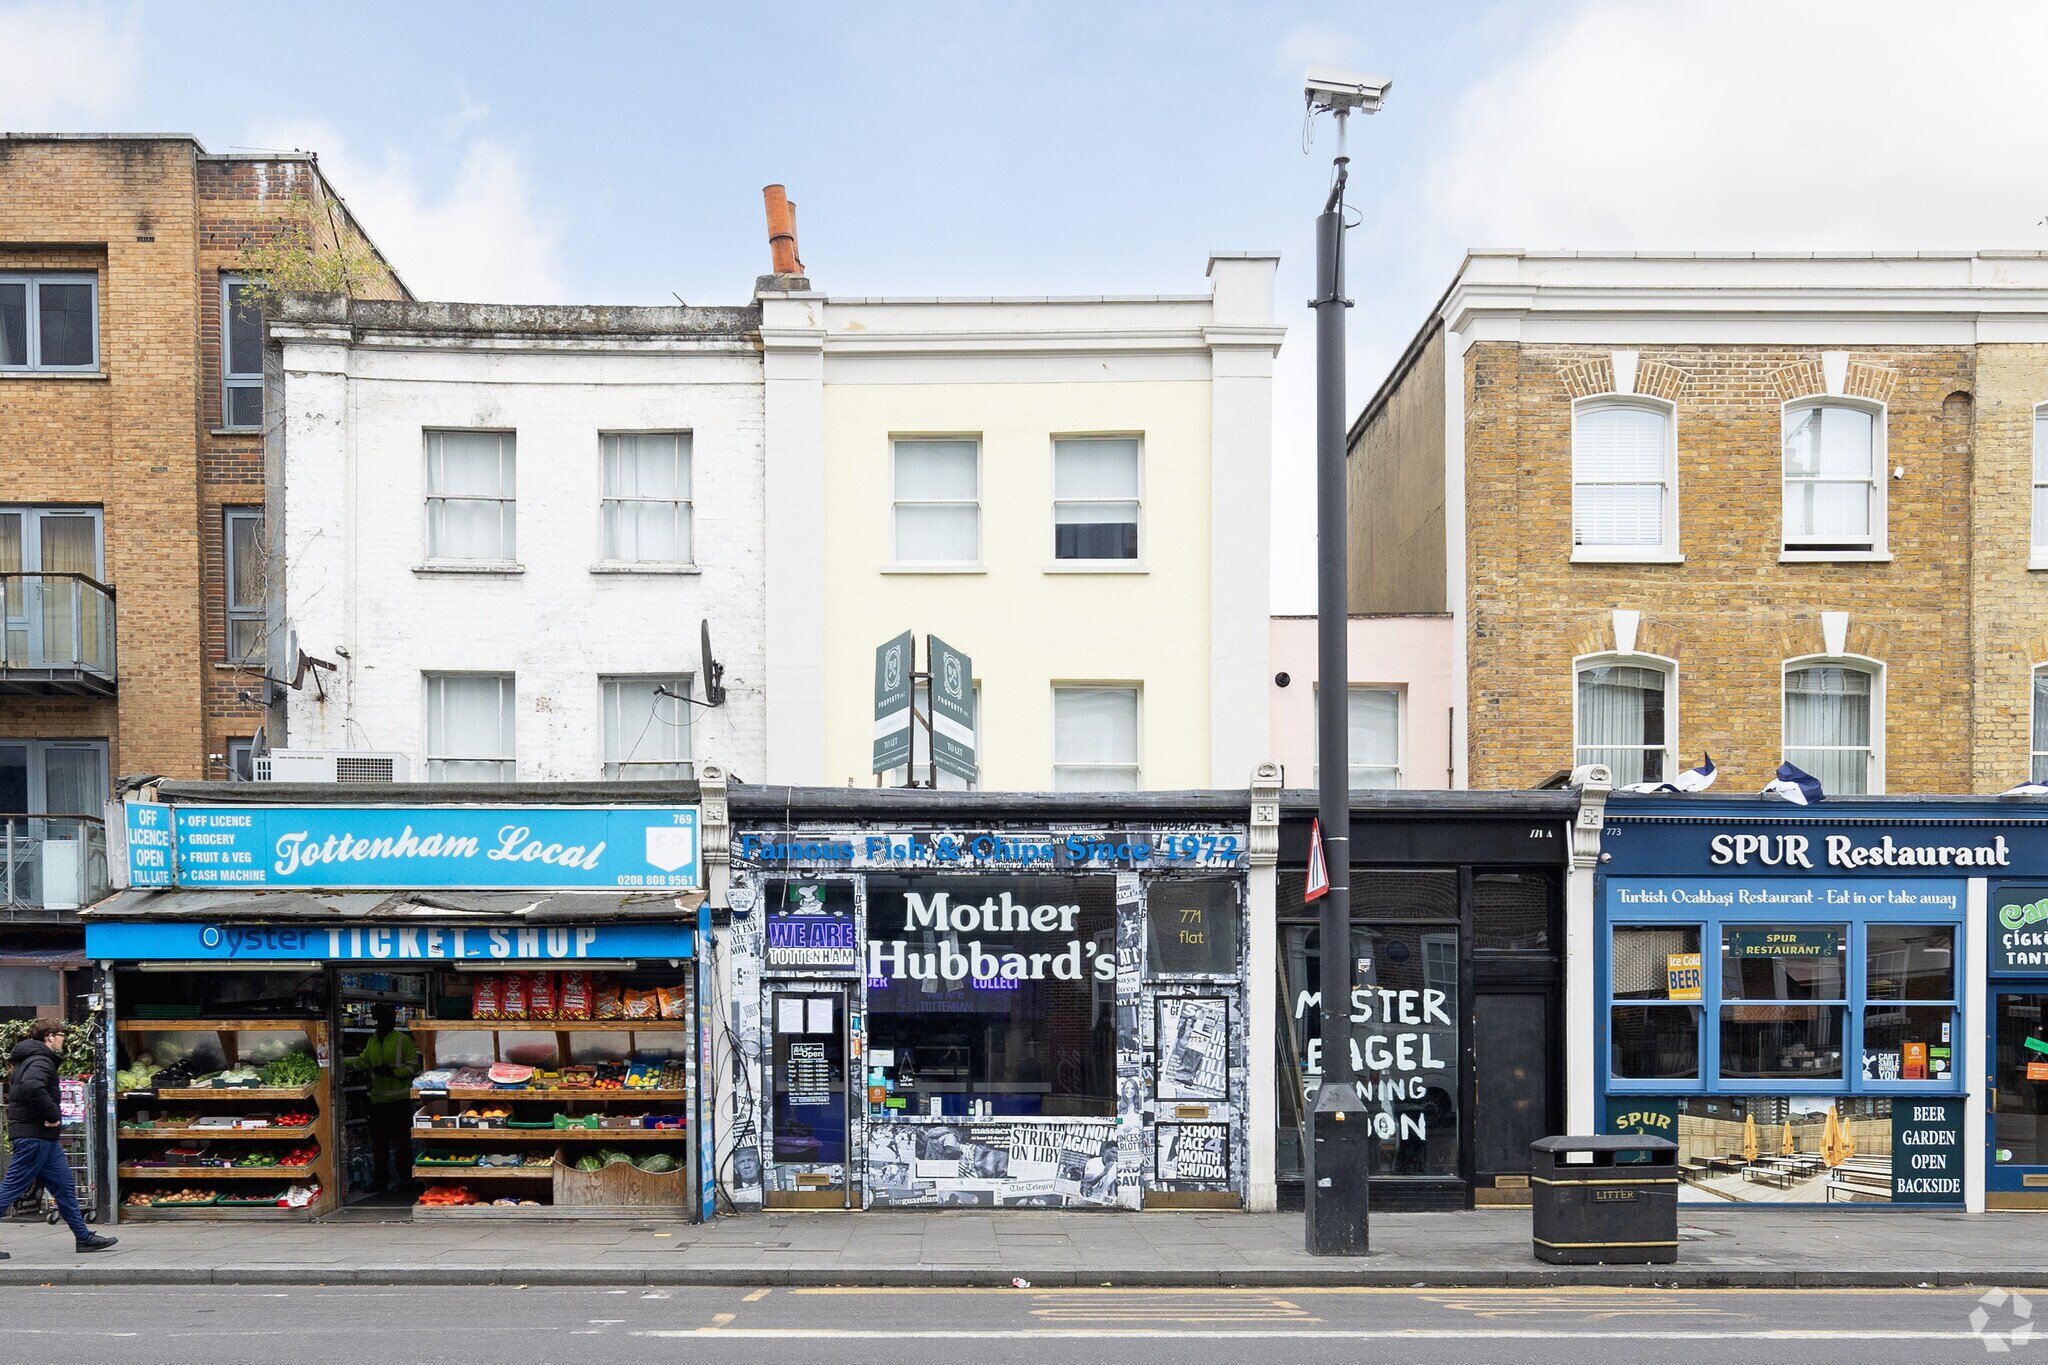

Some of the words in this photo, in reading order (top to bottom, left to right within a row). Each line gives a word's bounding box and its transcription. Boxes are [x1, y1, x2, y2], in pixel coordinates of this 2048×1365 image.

[878, 694, 900, 708] PROPERTY
[937, 695, 963, 714] PROPERTY
[884, 740, 891, 749] TO
[947, 743, 954, 753] TO
[954, 745, 963, 757] LET
[139, 809, 157, 826] OFF
[188, 815, 207, 827] OFF
[210, 816, 252, 827] LICENCE
[673, 814, 692, 824] 769
[129, 828, 169, 846] LICENCE
[189, 833, 235, 845] GROCERY
[1606, 827, 1622, 837] 773
[274, 824, 479, 875] Tottenham
[487, 825, 606, 870] Local
[741, 835, 855, 860] Famous
[866, 836, 925, 860] Fish
[935, 836, 961, 861] &
[972, 835, 1054, 865] Chips
[1066, 834, 1150, 860] Since
[1167, 835, 1238, 861] 1972
[1711, 834, 1814, 868] SPUR
[1825, 835, 2011, 868] Restaurant
[136, 849, 164, 867] OPEN
[190, 852, 219, 863] FRUIT
[222, 852, 230, 863] &
[232, 852, 252, 863] VEG
[134, 869, 150, 883] TILL
[151, 870, 169, 884] LATE
[191, 870, 218, 881] CASH
[220, 870, 266, 881] MACHINE
[617, 875, 643, 886] 0208
[646, 875, 665, 886] 808
[669, 875, 693, 886] 9561
[1617, 888, 1668, 903] Turkish
[1739, 889, 1813, 904] Restaurant
[1827, 889, 1852, 904] Eat
[1853, 890, 1866, 904] in
[1869, 894, 1885, 904] or
[1888, 889, 1918, 904] take
[1920, 893, 1957, 909] away
[903, 892, 1080, 931] Mother
[1180, 910, 1201, 923] 771
[199, 924, 312, 957] Oyster
[324, 928, 469, 958] TICKET
[489, 928, 597, 958] SHOP
[769, 922, 806, 948] WE
[809, 922, 854, 948] ARE
[1180, 931, 1204, 944] flat
[1766, 934, 1797, 943] SPUR
[769, 948, 854, 965] TOTTENHAM
[1746, 945, 1821, 955] RESTAURANT
[867, 940, 1116, 980] Hubbard's
[1670, 956, 1682, 966] Ice
[1683, 955, 1700, 966] Cold
[1670, 969, 1700, 990] BEER
[1295, 989, 1451, 1025] MSTER
[1308, 1033, 1445, 1074] GEL
[1616, 1112, 1671, 1129] SPUR
[1913, 1106, 1946, 1121] BEER
[1180, 1137, 1205, 1151] FACE
[1205, 1138, 1222, 1153] 4
[1902, 1130, 1956, 1145] GARDEN
[1012, 1145, 1028, 1160] ON
[1063, 1135, 1101, 1157] AGAIN
[1179, 1150, 1221, 1165] MONTH
[1911, 1154, 1947, 1169] OPEN
[1897, 1178, 1961, 1193] BACKSIDE
[889, 1193, 938, 1206] theguardian
[1596, 1190, 1634, 1200] LITTER
